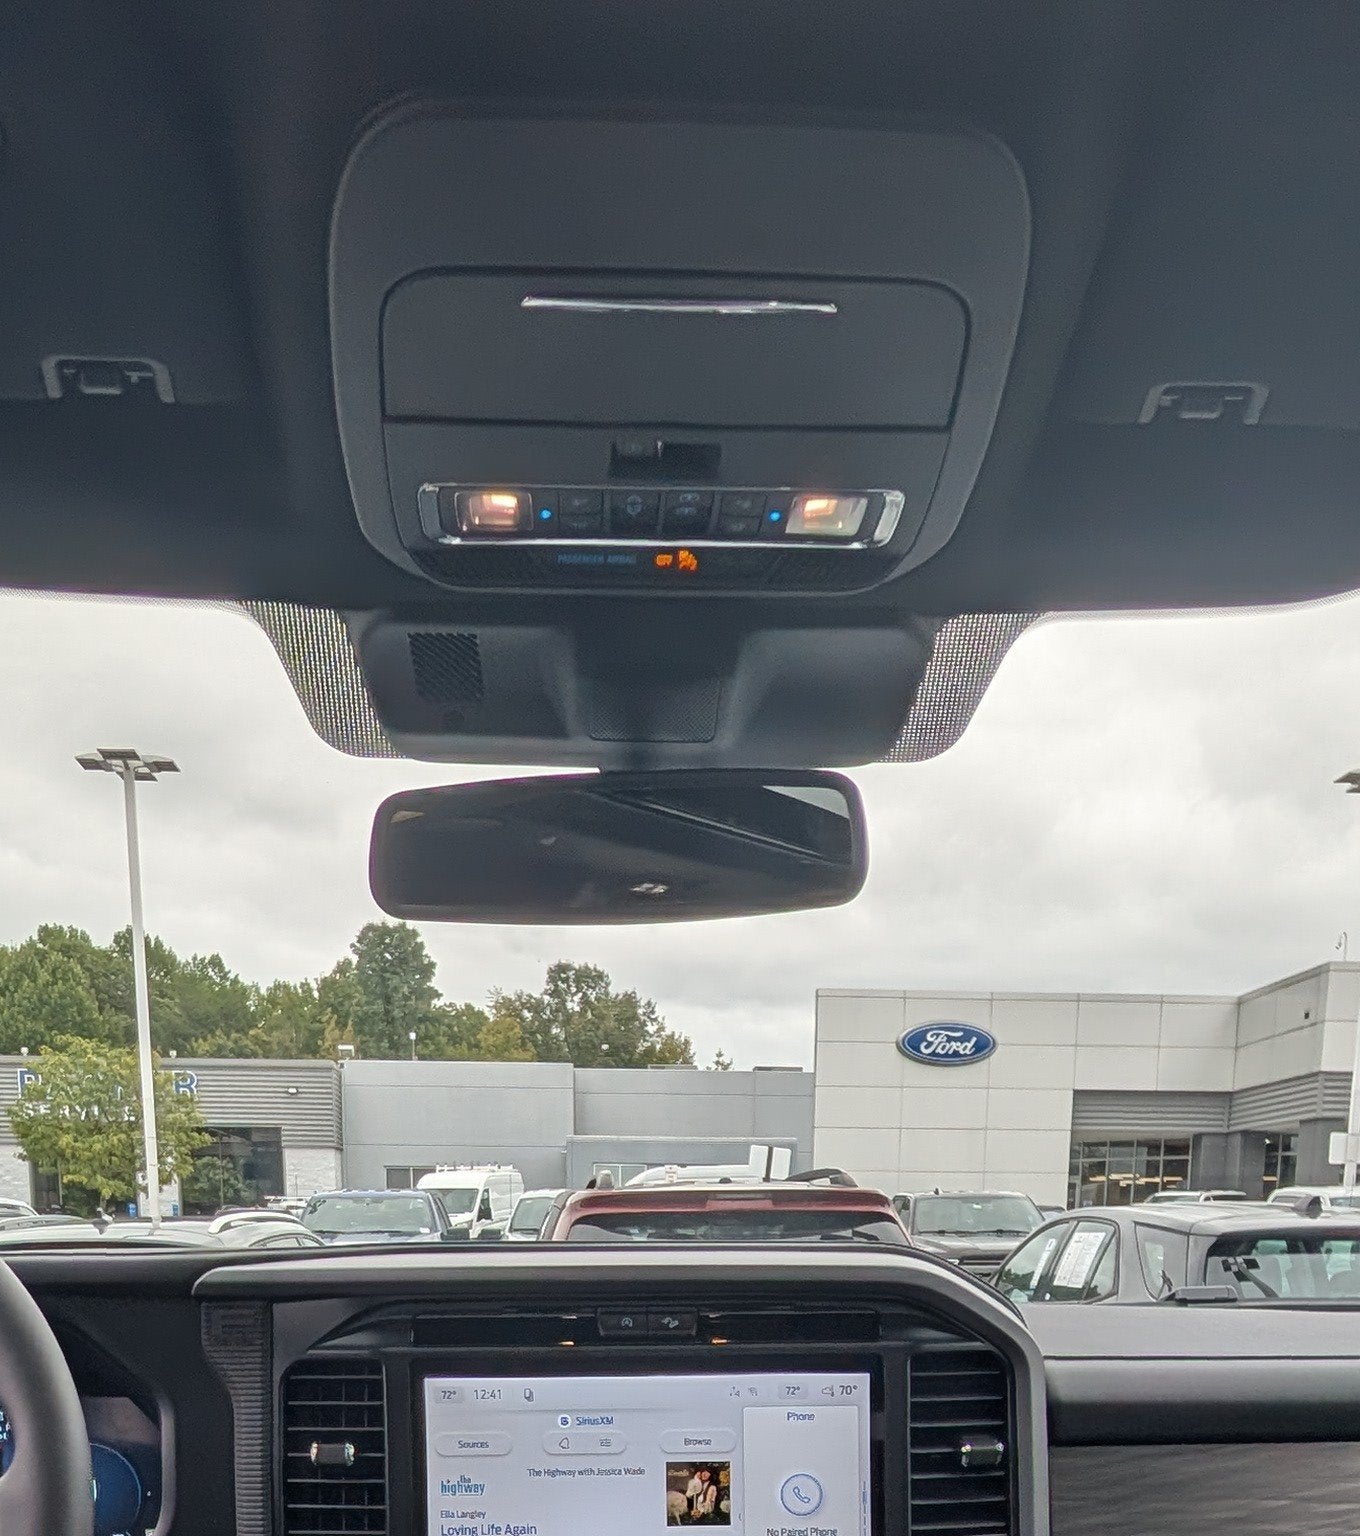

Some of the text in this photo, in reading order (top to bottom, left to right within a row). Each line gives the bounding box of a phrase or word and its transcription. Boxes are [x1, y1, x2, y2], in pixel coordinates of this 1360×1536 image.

[920, 1030, 978, 1055] Ford
[474, 1389, 502, 1400] 12:41
[839, 1384, 858, 1396] 70°
[576, 1416, 614, 1426] SiriusXM
[787, 1411, 815, 1421] Phone
[458, 1440, 489, 1449] Sources
[683, 1437, 712, 1446] Browse
[527, 1466, 646, 1478] The Highway with Jessica Wade
[440, 1480, 486, 1495] highway
[440, 1510, 487, 1520] Ella Langley
[481, 1524, 502, 1536] Life
[766, 1527, 837, 1536] No Paired Phone
